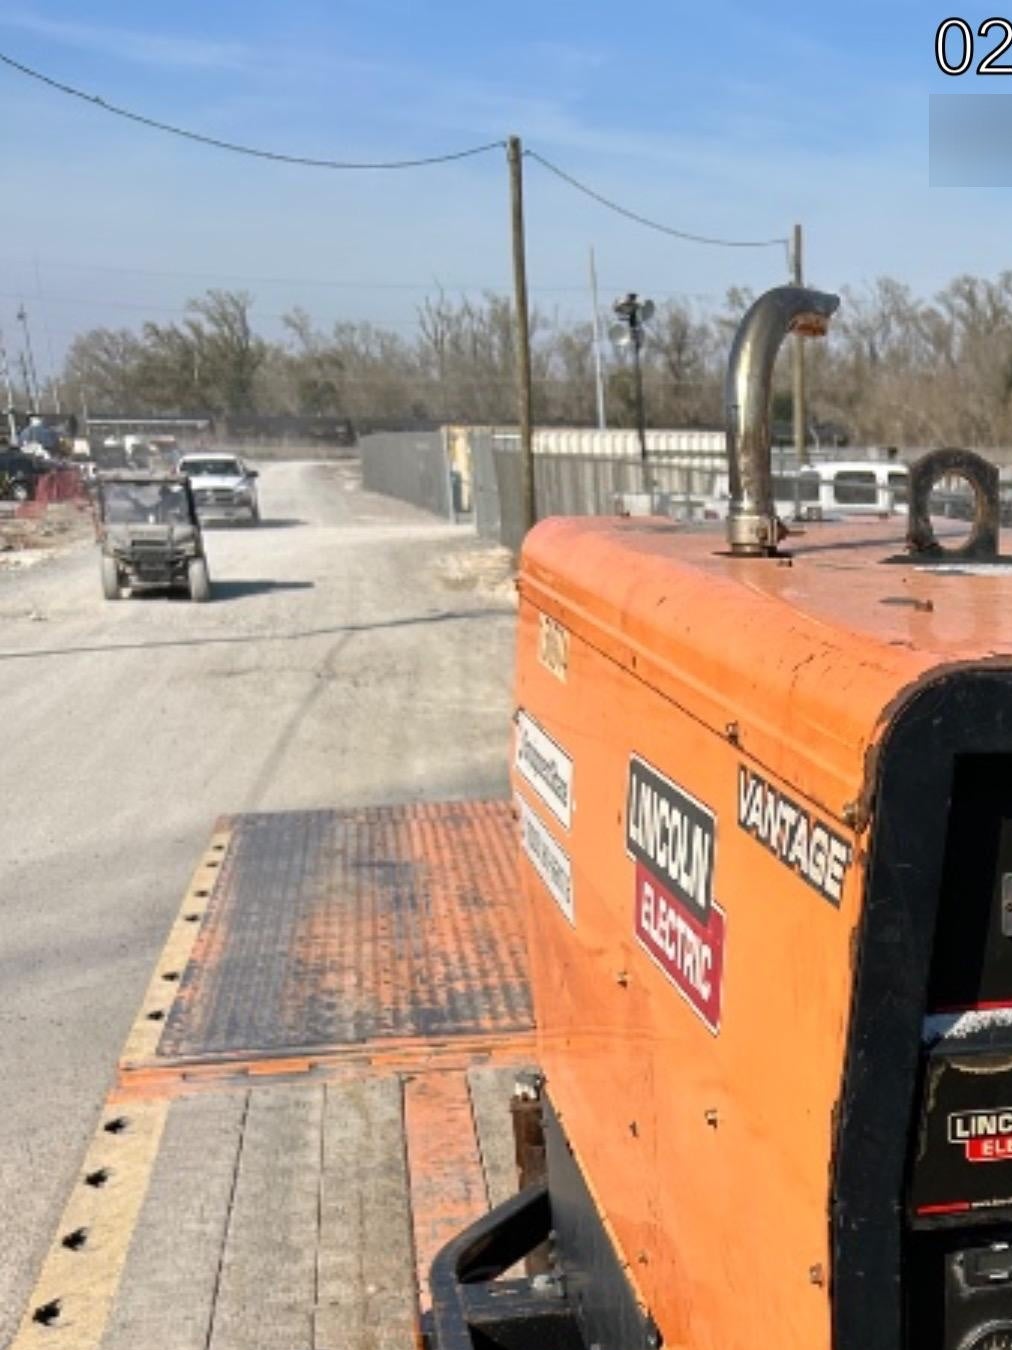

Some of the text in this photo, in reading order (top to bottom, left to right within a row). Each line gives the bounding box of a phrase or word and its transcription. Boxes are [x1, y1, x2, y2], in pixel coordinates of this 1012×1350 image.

[629, 773, 711, 910] LINCOLN
[740, 770, 847, 901] VANTAGE
[640, 881, 712, 1002] ELECTRIC
